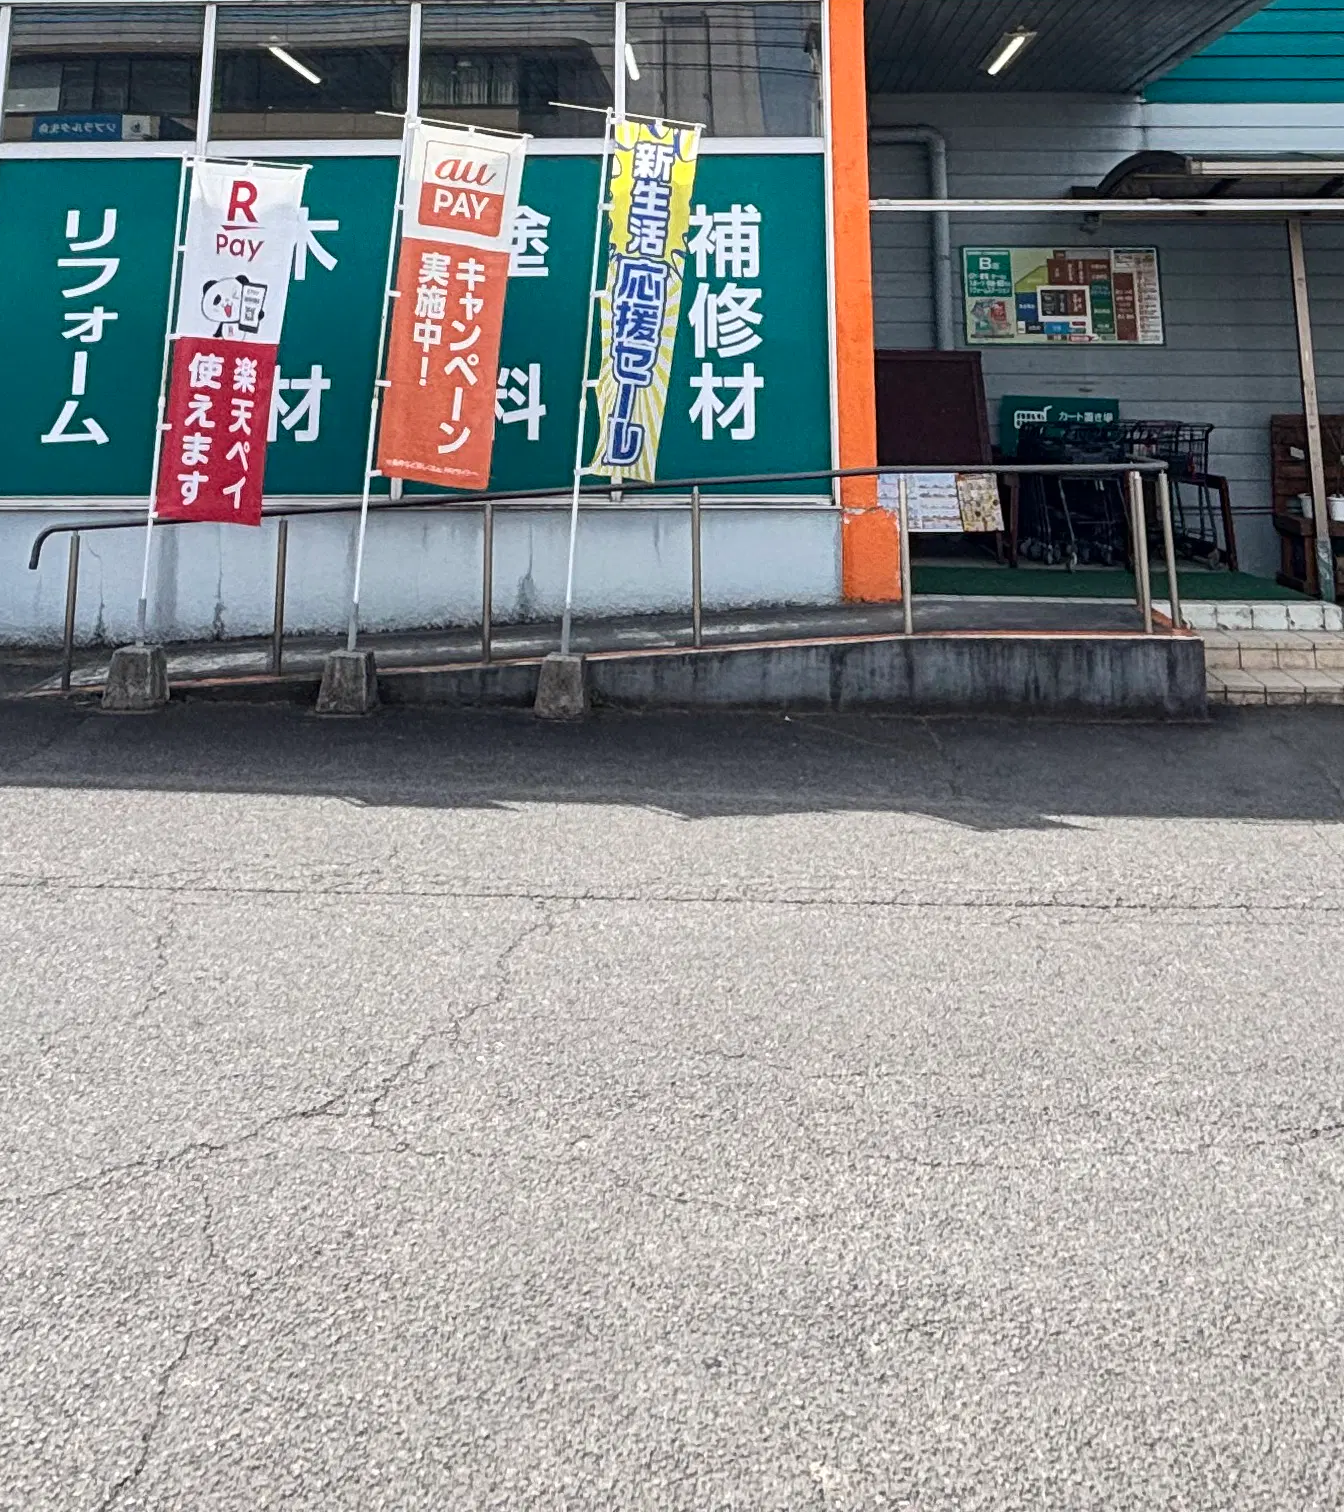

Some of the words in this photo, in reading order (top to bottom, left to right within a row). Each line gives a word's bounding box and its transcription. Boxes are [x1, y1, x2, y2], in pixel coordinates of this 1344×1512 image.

[216, 233, 264, 262] Pay
[227, 180, 258, 223] R
[433, 189, 490, 220] PAY
[434, 159, 496, 186] au
[41, 208, 120, 444] リフォーム
[438, 257, 486, 454] キャンペーン
[608, 142, 676, 465] 新生活応援セール
[688, 203, 764, 440] 補修材
[177, 352, 225, 506] 使えます
[222, 356, 258, 510] 楽天ペイ
[1058, 411, 1114, 423] カート置き場
